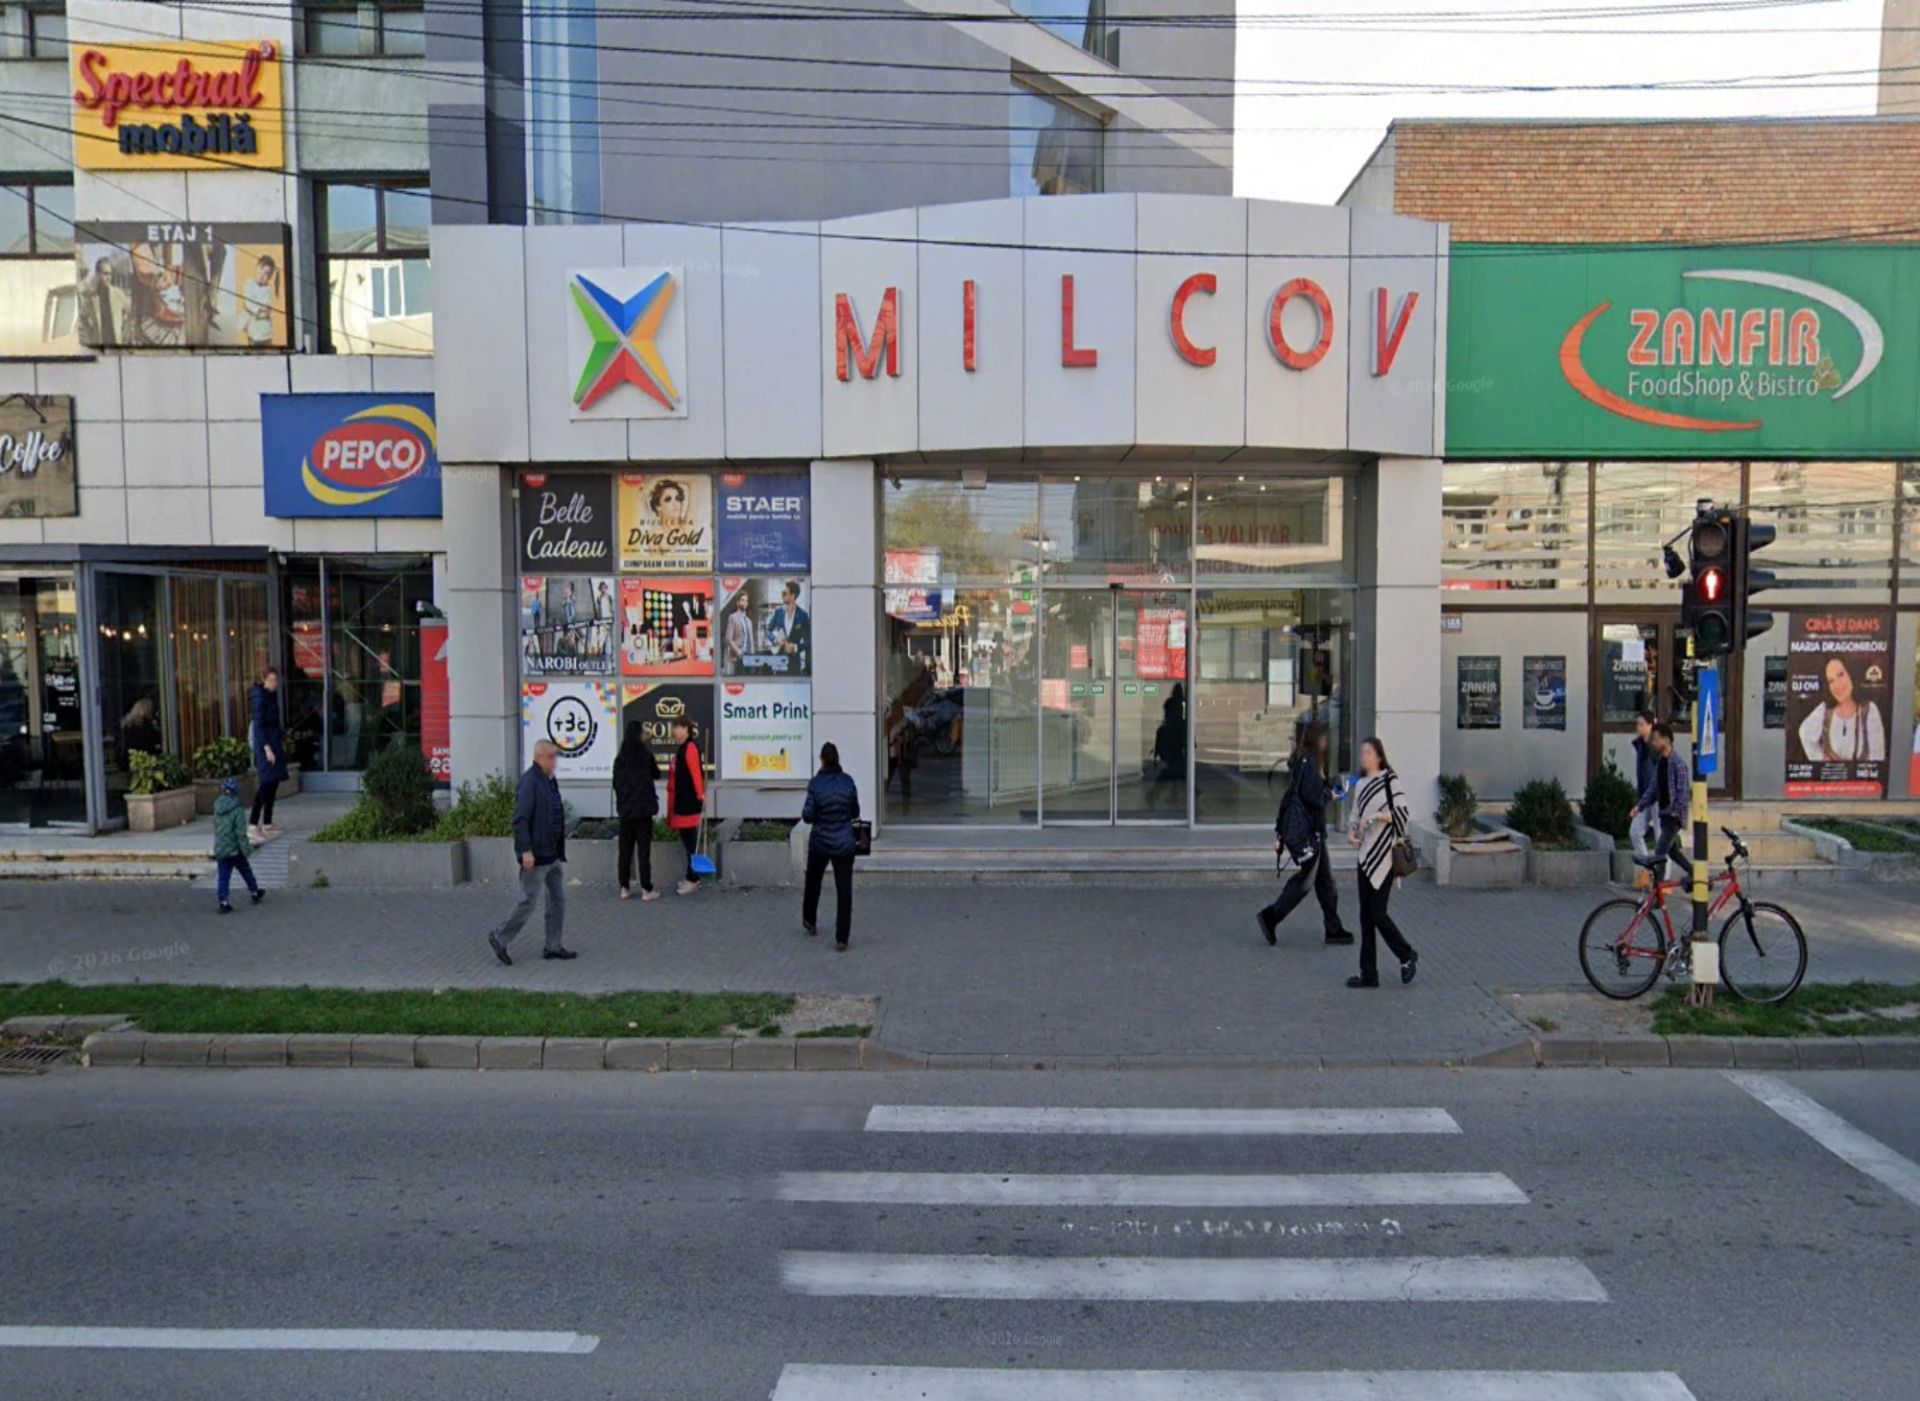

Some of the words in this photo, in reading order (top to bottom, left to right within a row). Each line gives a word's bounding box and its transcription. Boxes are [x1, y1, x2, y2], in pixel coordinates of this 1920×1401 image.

[74, 49, 263, 127] Spectral
[119, 113, 257, 155] mobilă
[147, 226, 198, 242] ETAJ
[206, 227, 214, 241] 1
[835, 274, 1418, 381] MILCOV
[1627, 308, 1820, 366] ZANFIR
[1627, 371, 1733, 401] FoodShop
[0, 431, 64, 473] Coffee
[322, 438, 416, 470] PEPCO
[539, 491, 594, 525] Belle
[726, 496, 801, 512] STAER
[527, 526, 608, 560] Cadeau
[627, 528, 664, 546] Diva
[666, 527, 705, 546] Gold
[723, 702, 768, 720] Smart
[773, 701, 809, 720] Print
